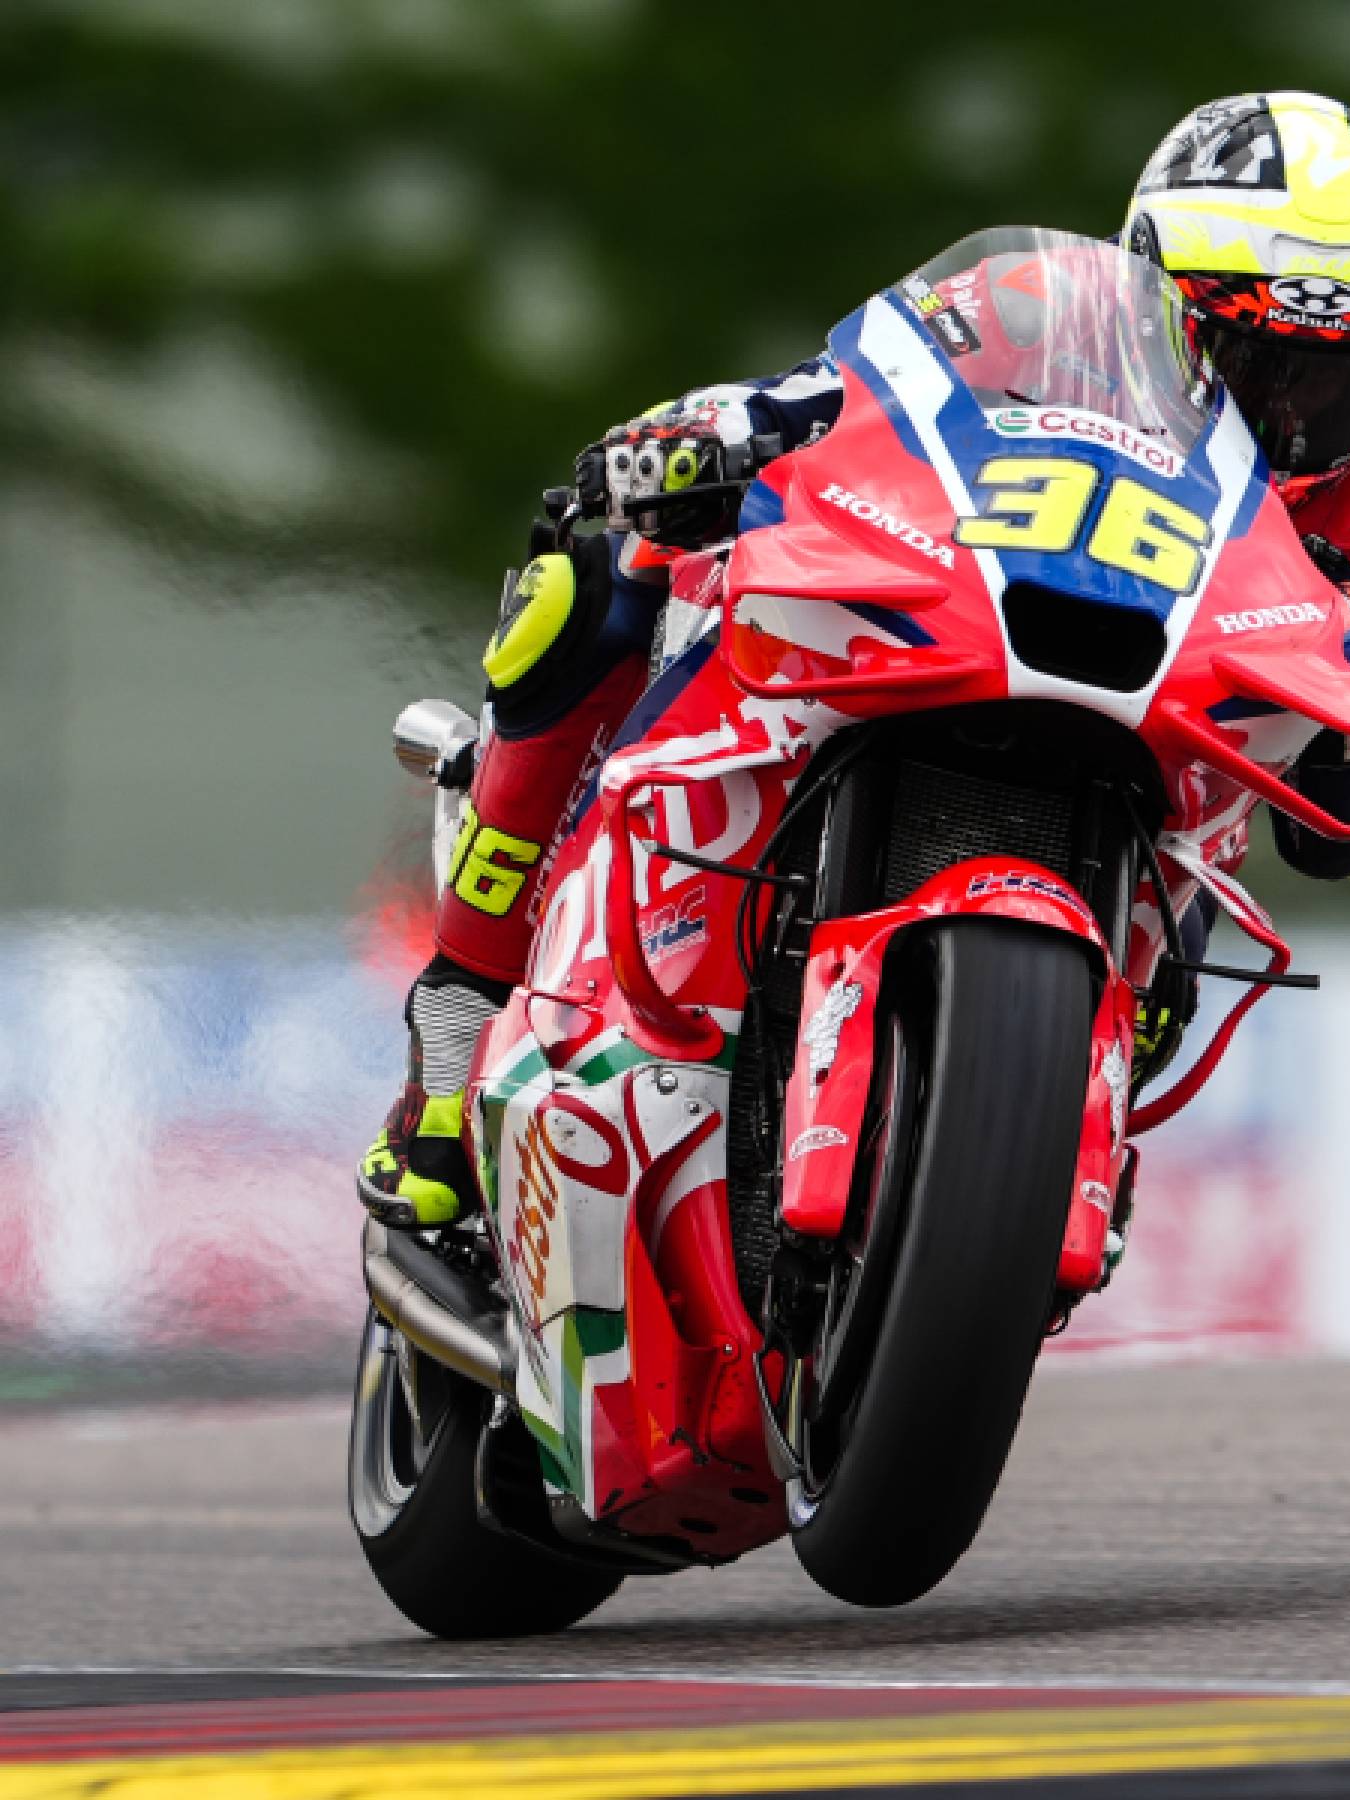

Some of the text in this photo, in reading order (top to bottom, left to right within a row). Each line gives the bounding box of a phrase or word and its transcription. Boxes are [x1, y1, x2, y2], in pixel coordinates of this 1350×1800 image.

[1036, 410, 1175, 475] Castrol
[818, 482, 956, 571] HONDA
[955, 457, 1213, 597] 36
[1213, 602, 1327, 634] HONDA
